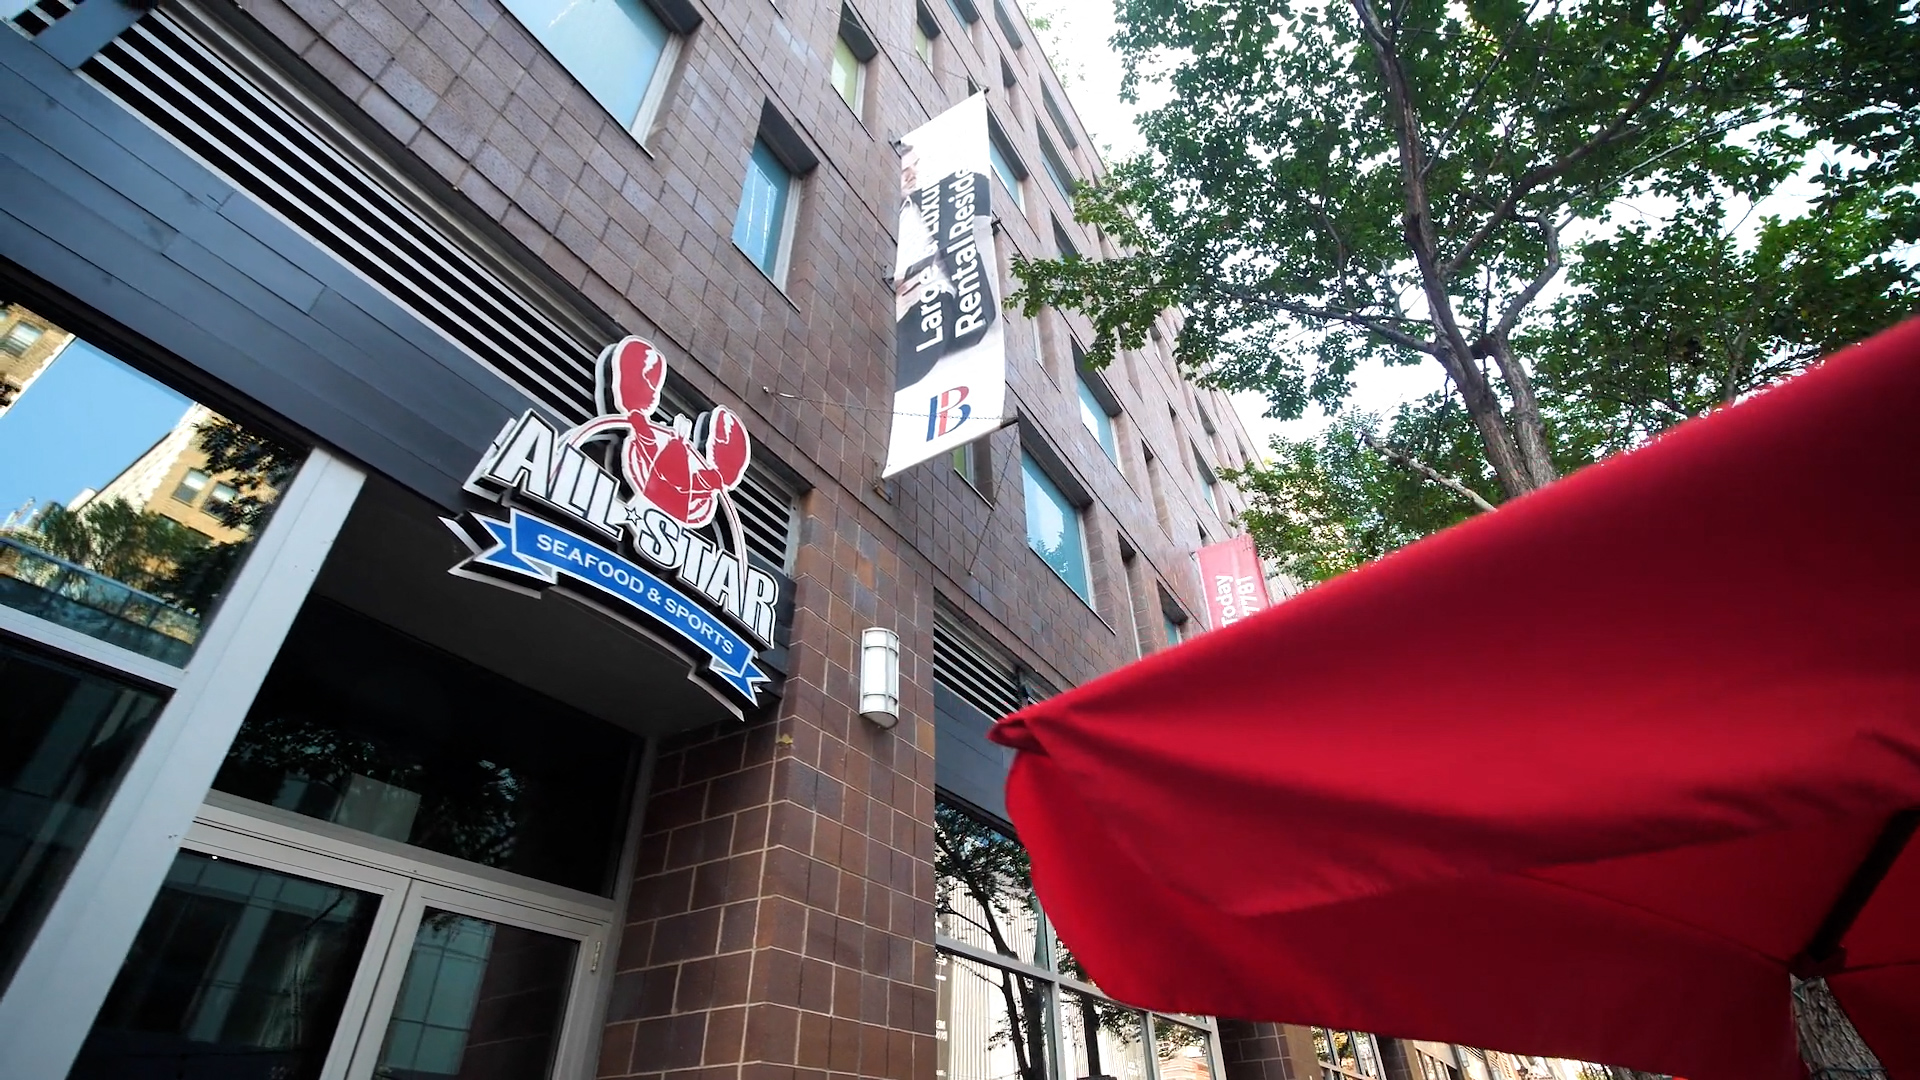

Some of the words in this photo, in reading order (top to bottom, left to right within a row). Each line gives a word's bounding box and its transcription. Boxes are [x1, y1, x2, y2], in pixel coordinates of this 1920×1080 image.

[920, 182, 940, 238] Luxu
[915, 264, 949, 353] Large
[946, 233, 986, 338] Rental
[486, 409, 623, 541] ALL
[638, 508, 778, 649] STAR
[536, 533, 644, 594] SEAFOOD
[646, 586, 662, 605] &
[663, 598, 735, 655] SPORTS
[1215, 575, 1238, 628] Today
